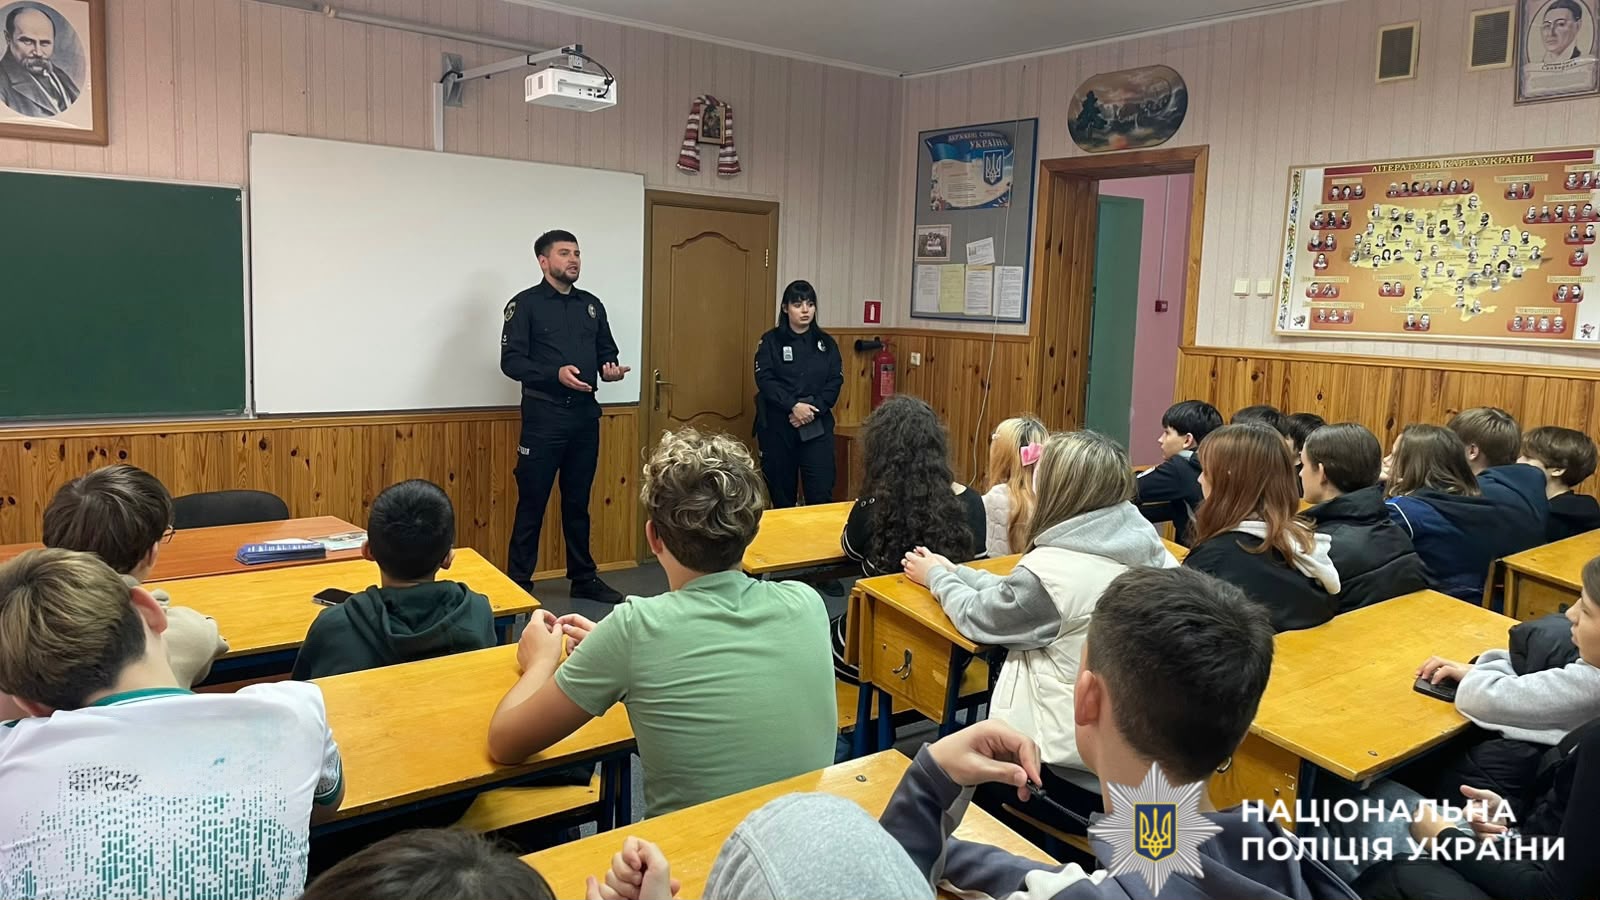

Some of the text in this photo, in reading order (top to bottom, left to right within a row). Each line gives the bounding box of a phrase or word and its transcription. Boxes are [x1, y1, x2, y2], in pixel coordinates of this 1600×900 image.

[969, 138, 1008, 149] УКРАЇНИ
[1371, 155, 1534, 173] ЛІТЕРАТУРНА КАРТА УКРАЇНИ
